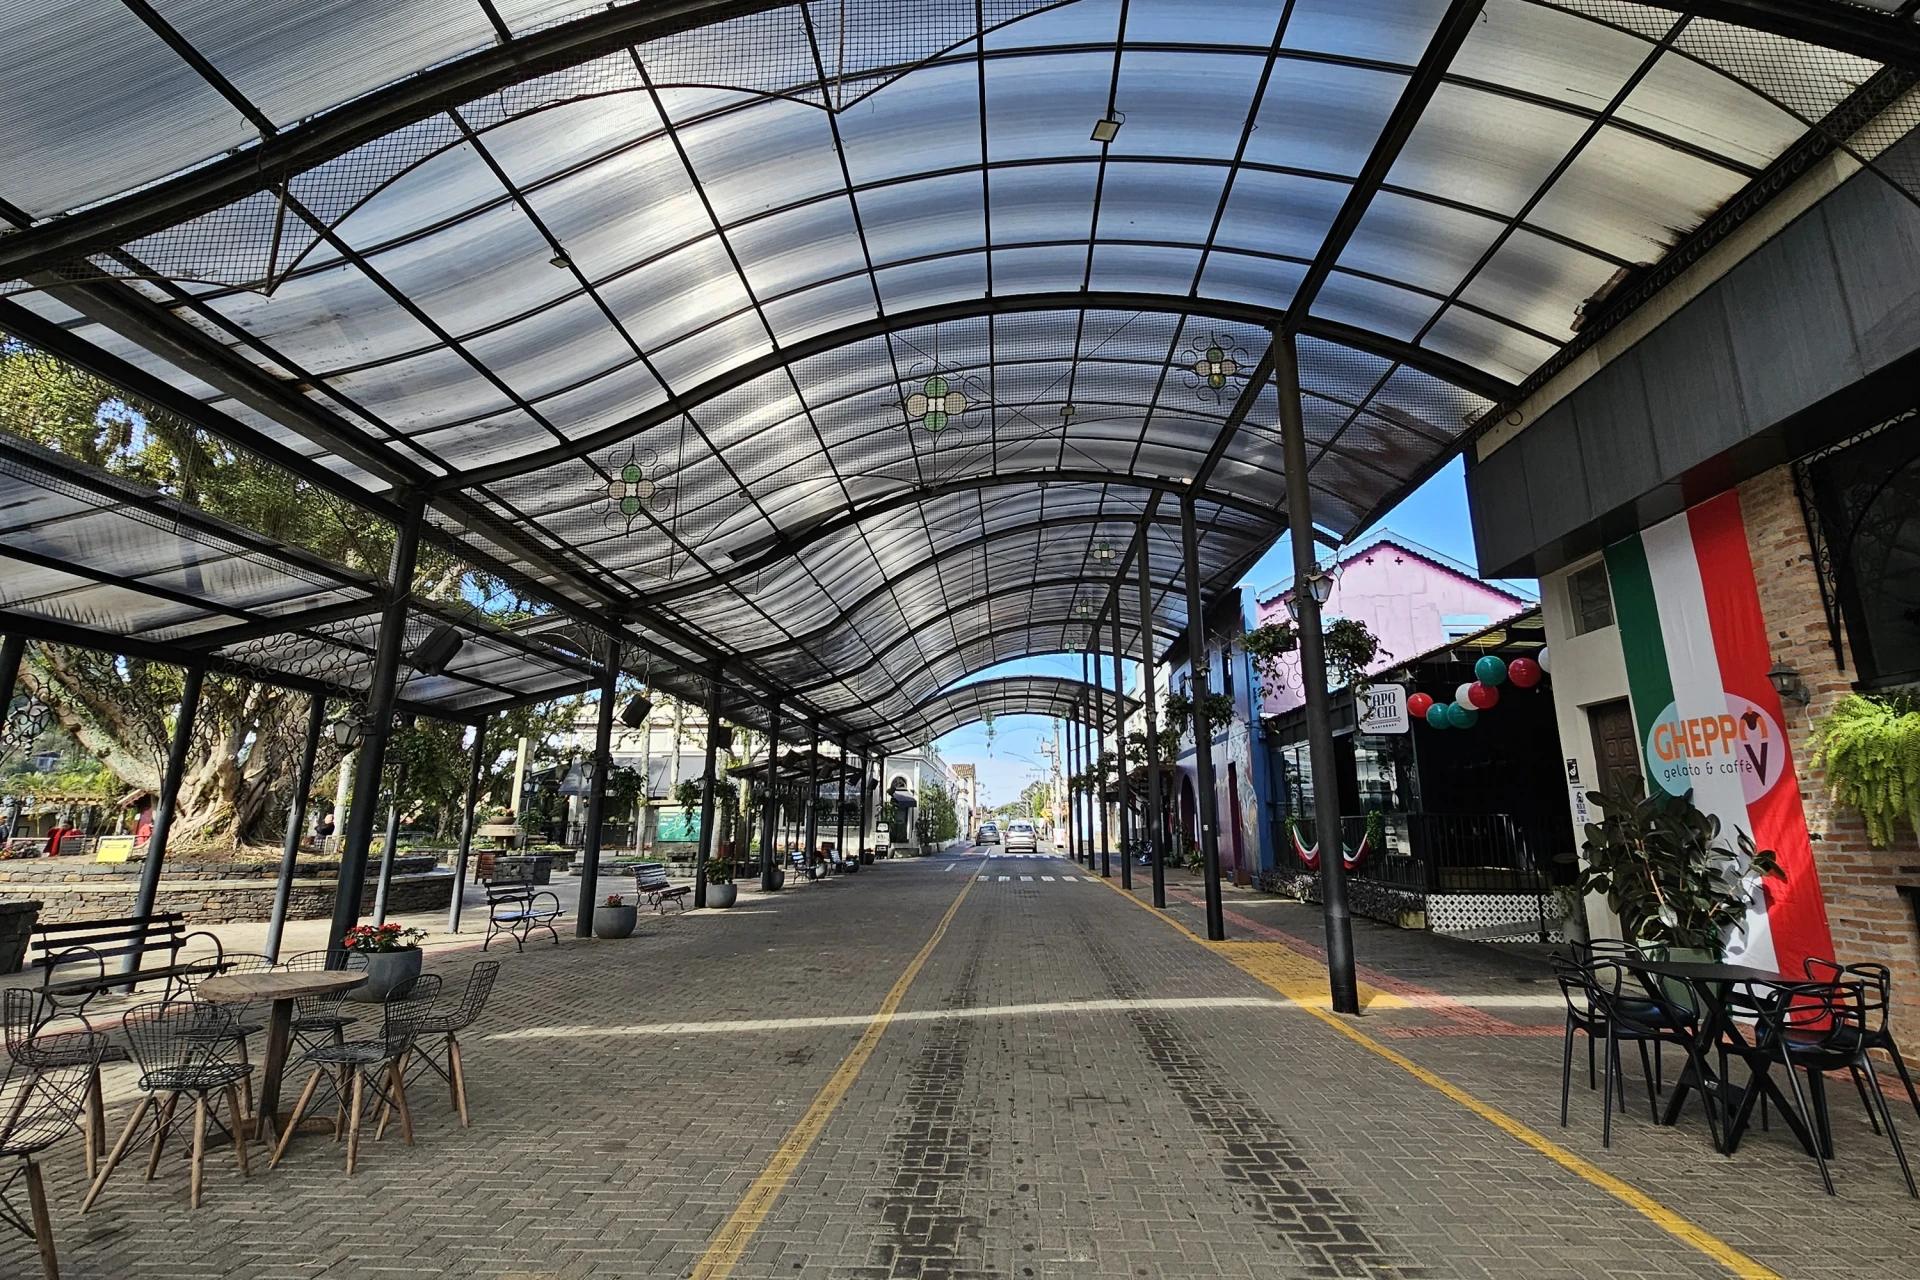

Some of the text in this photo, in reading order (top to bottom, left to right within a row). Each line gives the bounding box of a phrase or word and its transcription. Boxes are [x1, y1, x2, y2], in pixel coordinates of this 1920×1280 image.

[1664, 759, 1753, 782] gelato & caffè
